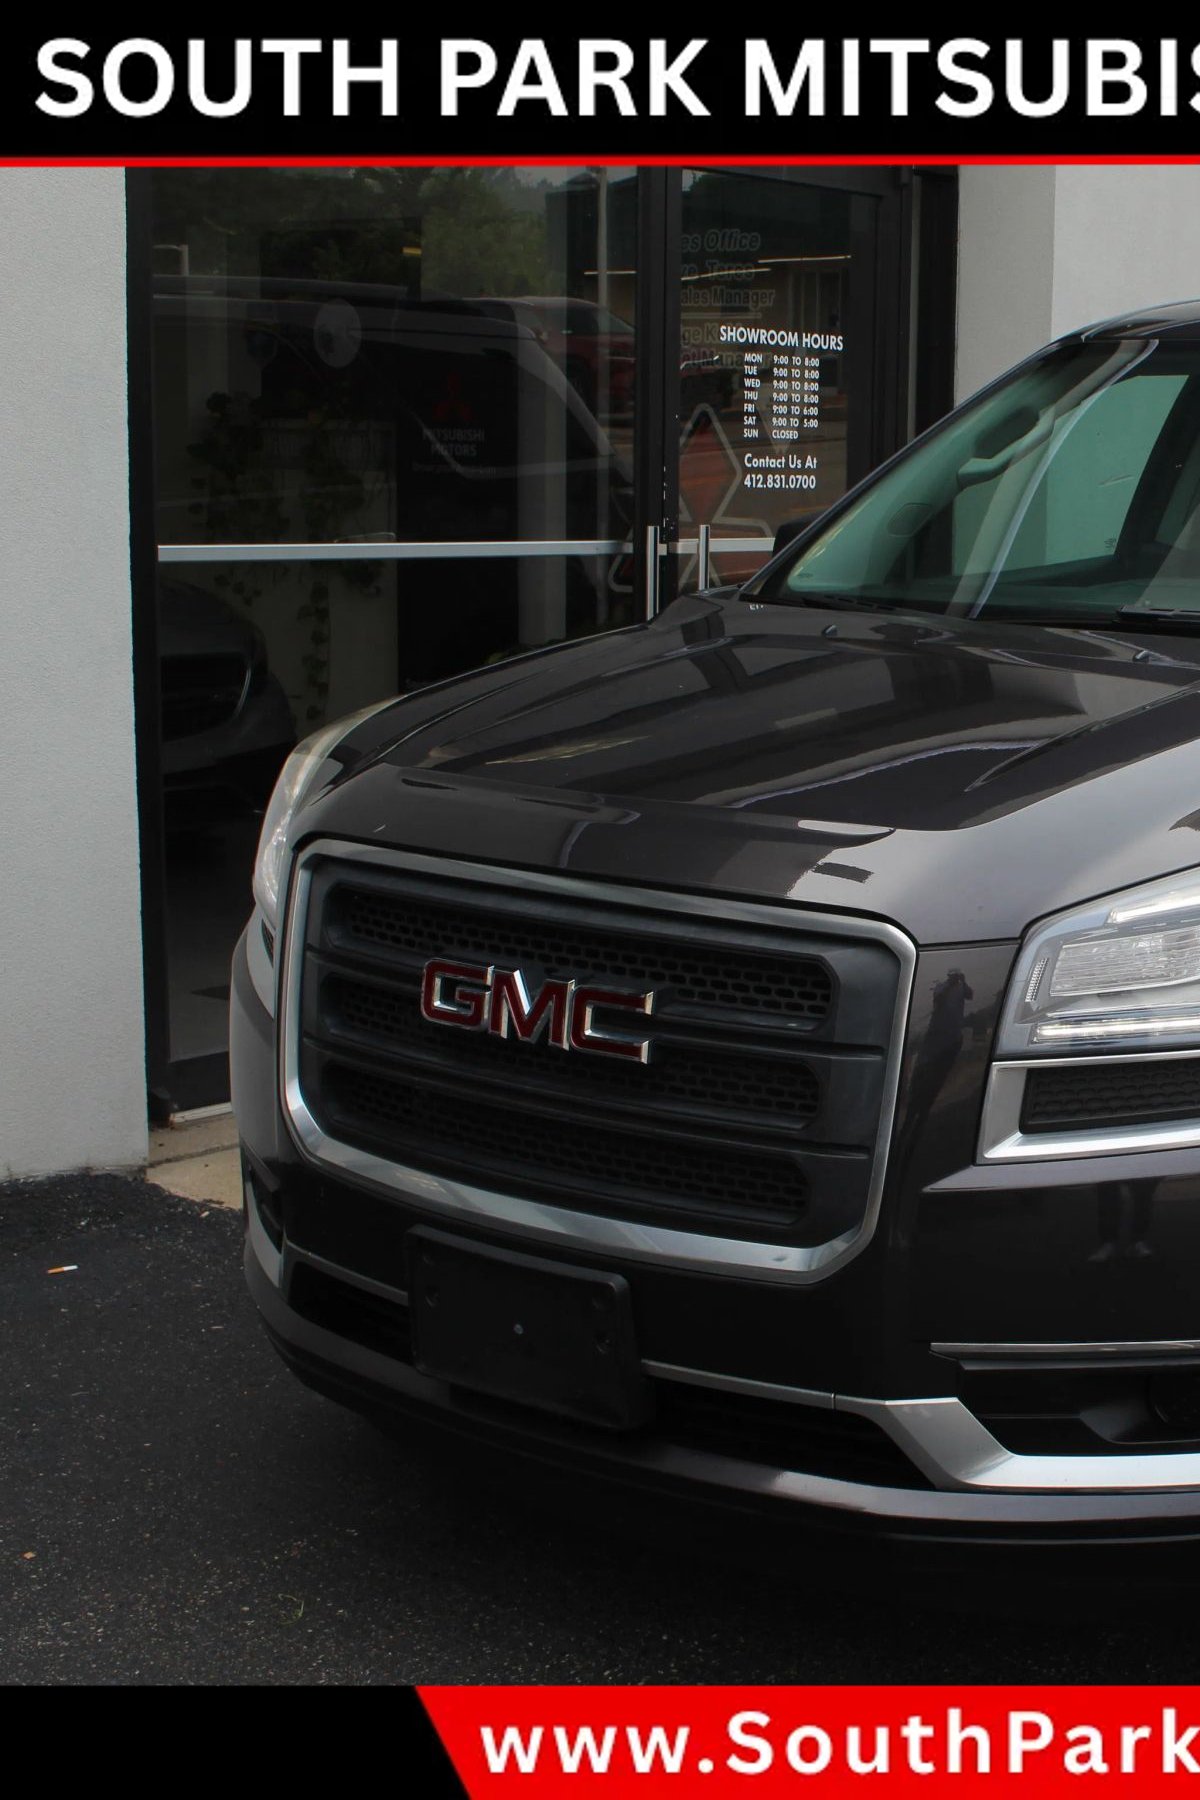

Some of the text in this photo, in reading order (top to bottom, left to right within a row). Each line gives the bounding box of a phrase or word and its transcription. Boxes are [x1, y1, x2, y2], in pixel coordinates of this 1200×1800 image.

[720, 325, 799, 347] SHOWROOM
[802, 332, 844, 351] HOURS
[744, 353, 820, 367] MON 9:00 TO 8:00
[744, 365, 820, 379] TUE 9:00 TO 8:00
[744, 378, 819, 391] WED 9:00 TO 8:00
[744, 391, 819, 404] THU 9:00 TO 8:00
[743, 403, 819, 416] FRI 9:00 TO 6:00
[743, 416, 819, 428] SAT 9:00 TO 5:00
[743, 428, 799, 439] SUN CLOSED
[744, 453, 818, 469] Contact Us At
[744, 474, 817, 489] 412.831.0700
[421, 958, 654, 1065] GMC
